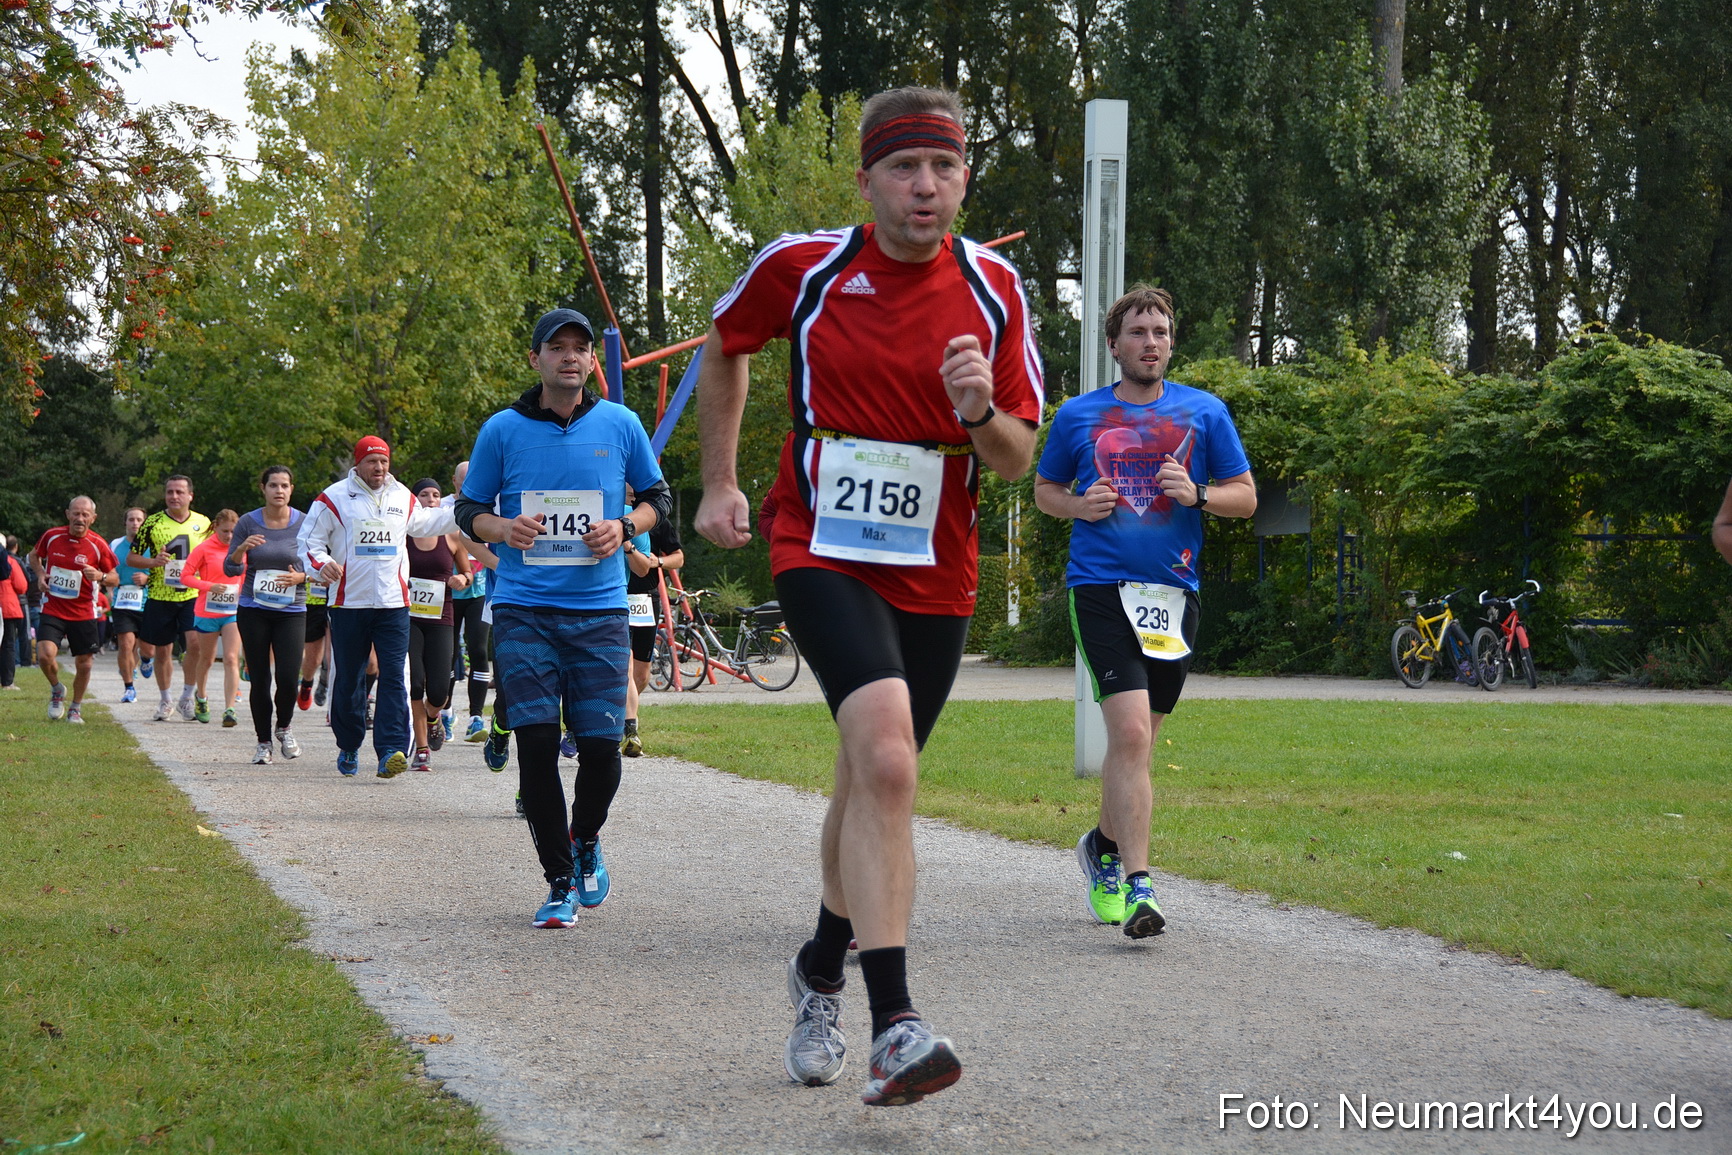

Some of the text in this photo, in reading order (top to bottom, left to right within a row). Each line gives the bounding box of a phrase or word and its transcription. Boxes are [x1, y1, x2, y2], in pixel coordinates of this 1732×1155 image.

[841, 285, 876, 295] adidas
[866, 452, 910, 467] BOCK
[1109, 460, 1165, 477] FINISHE
[834, 476, 921, 519] 2158
[1118, 486, 1142, 496] RELAY
[551, 496, 580, 505] BOCK
[1133, 496, 1154, 507] 2017
[387, 506, 404, 515] JURA
[359, 531, 392, 544] 2244
[861, 527, 887, 541] Max
[552, 543, 573, 553] Mate
[53, 575, 76, 589] 2318
[260, 580, 288, 594] 2087
[119, 592, 138, 601] 2400
[211, 592, 235, 603] 2356
[412, 590, 434, 604] 127
[1135, 605, 1169, 631] 239
[1142, 635, 1166, 648] Manuel
